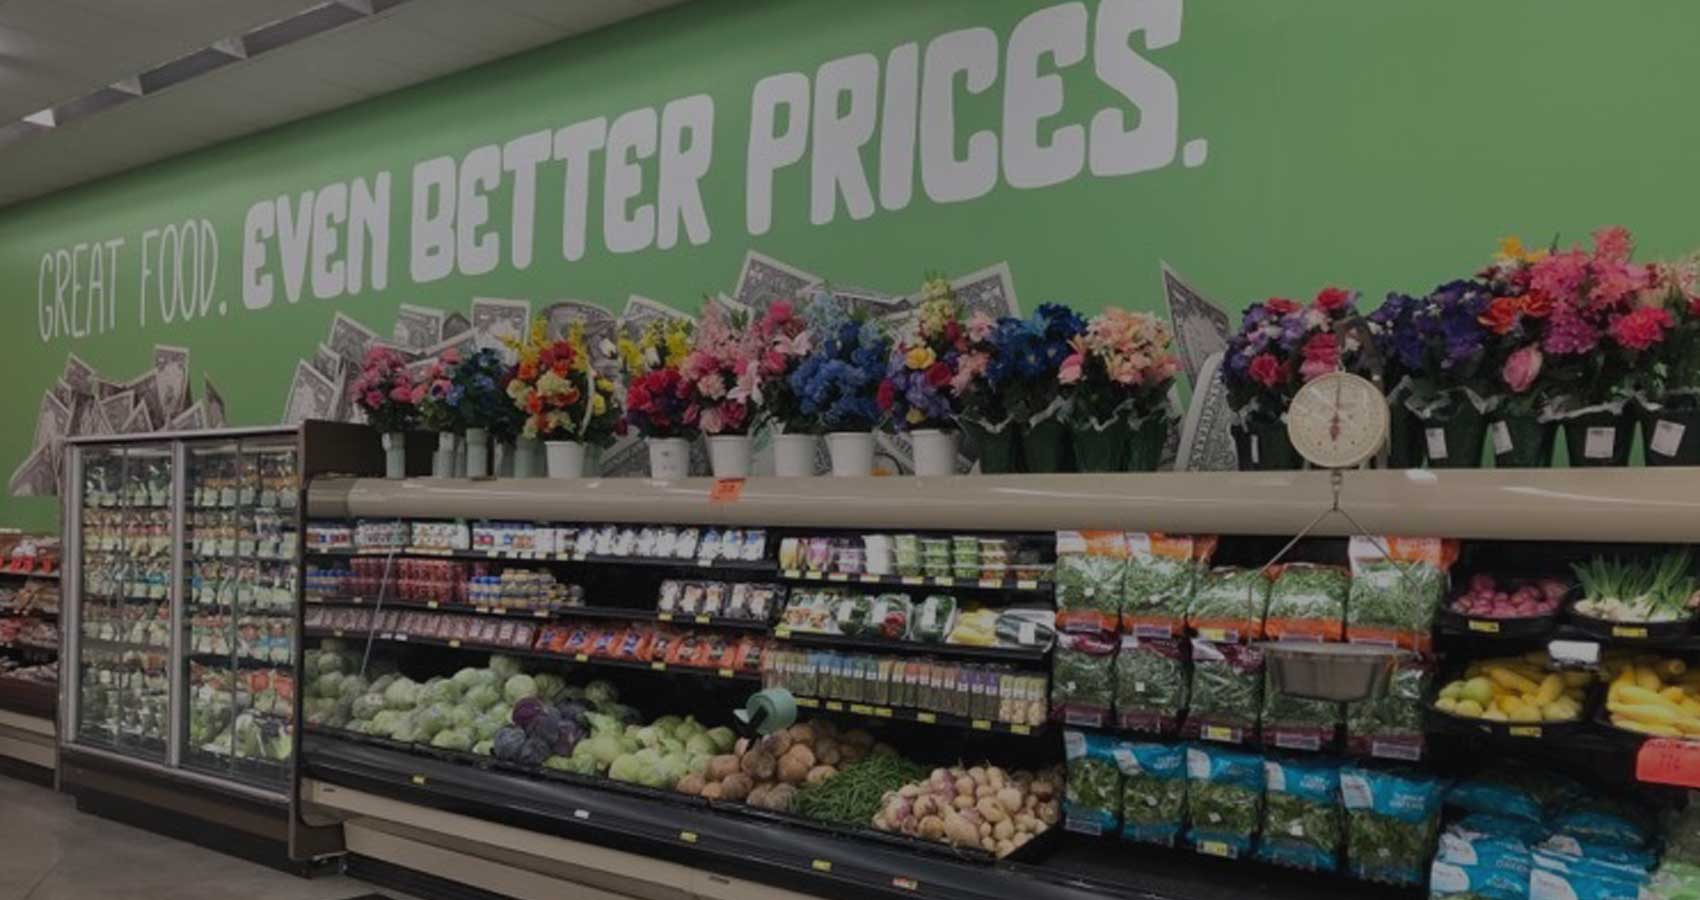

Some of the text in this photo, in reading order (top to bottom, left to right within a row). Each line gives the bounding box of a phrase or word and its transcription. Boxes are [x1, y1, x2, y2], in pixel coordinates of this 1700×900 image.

[38, 0, 1208, 342] GREAT FOOD. EVEN BETTER PRICES.
